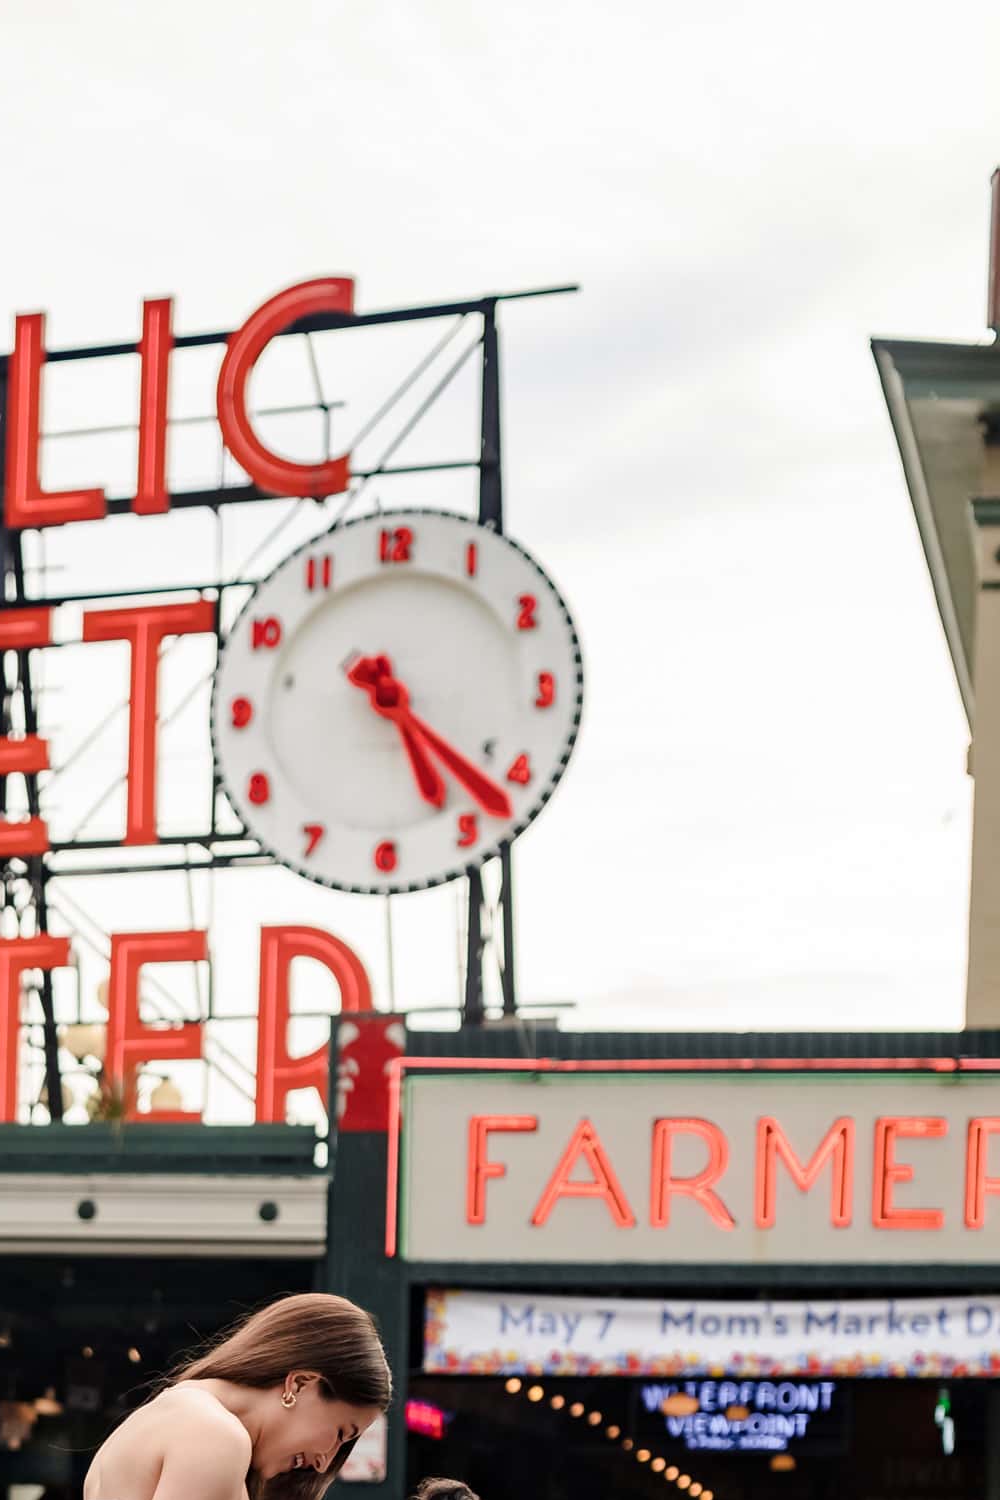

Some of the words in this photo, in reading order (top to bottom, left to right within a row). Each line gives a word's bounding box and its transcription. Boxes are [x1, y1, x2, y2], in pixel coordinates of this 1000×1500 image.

[379, 527, 414, 563] 12
[466, 542, 478, 577] 1
[305, 556, 332, 589] 11
[515, 593, 538, 630] 2
[251, 616, 282, 650] 10
[535, 671, 556, 709] 3
[230, 696, 254, 730] 9
[506, 753, 532, 787] 4
[247, 771, 271, 806] 8
[304, 824, 325, 856] 7
[457, 812, 480, 849] 5
[372, 840, 398, 874] 6
[500, 1303, 582, 1344] May
[597, 1309, 616, 1339] 7
[660, 1303, 788, 1336] Mom's
[803, 1301, 947, 1336] Market
